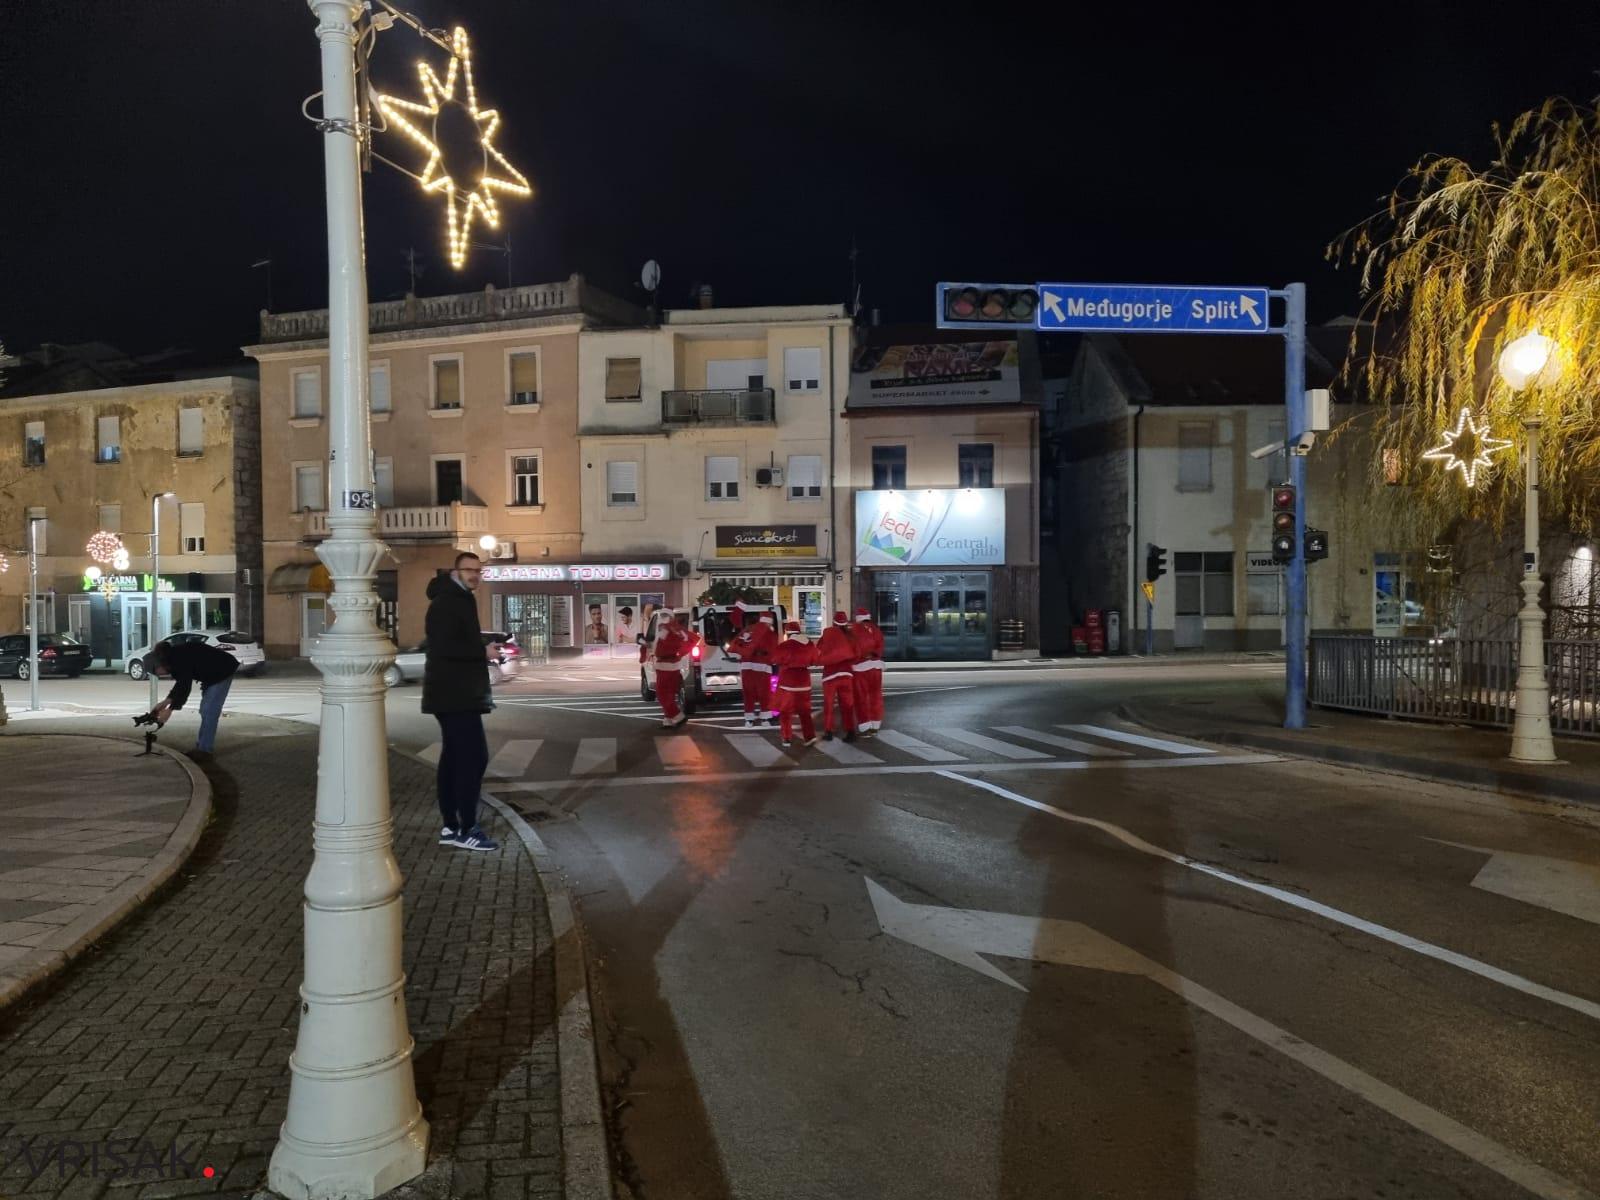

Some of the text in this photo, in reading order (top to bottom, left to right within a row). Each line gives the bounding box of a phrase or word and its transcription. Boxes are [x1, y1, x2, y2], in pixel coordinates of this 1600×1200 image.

[1191, 299, 1238, 323] Split
[880, 511, 916, 541] leda
[936, 537, 988, 549] Central
[971, 545, 998, 559] pub
[482, 565, 664, 580] ZLATARNA TONI GOLD
